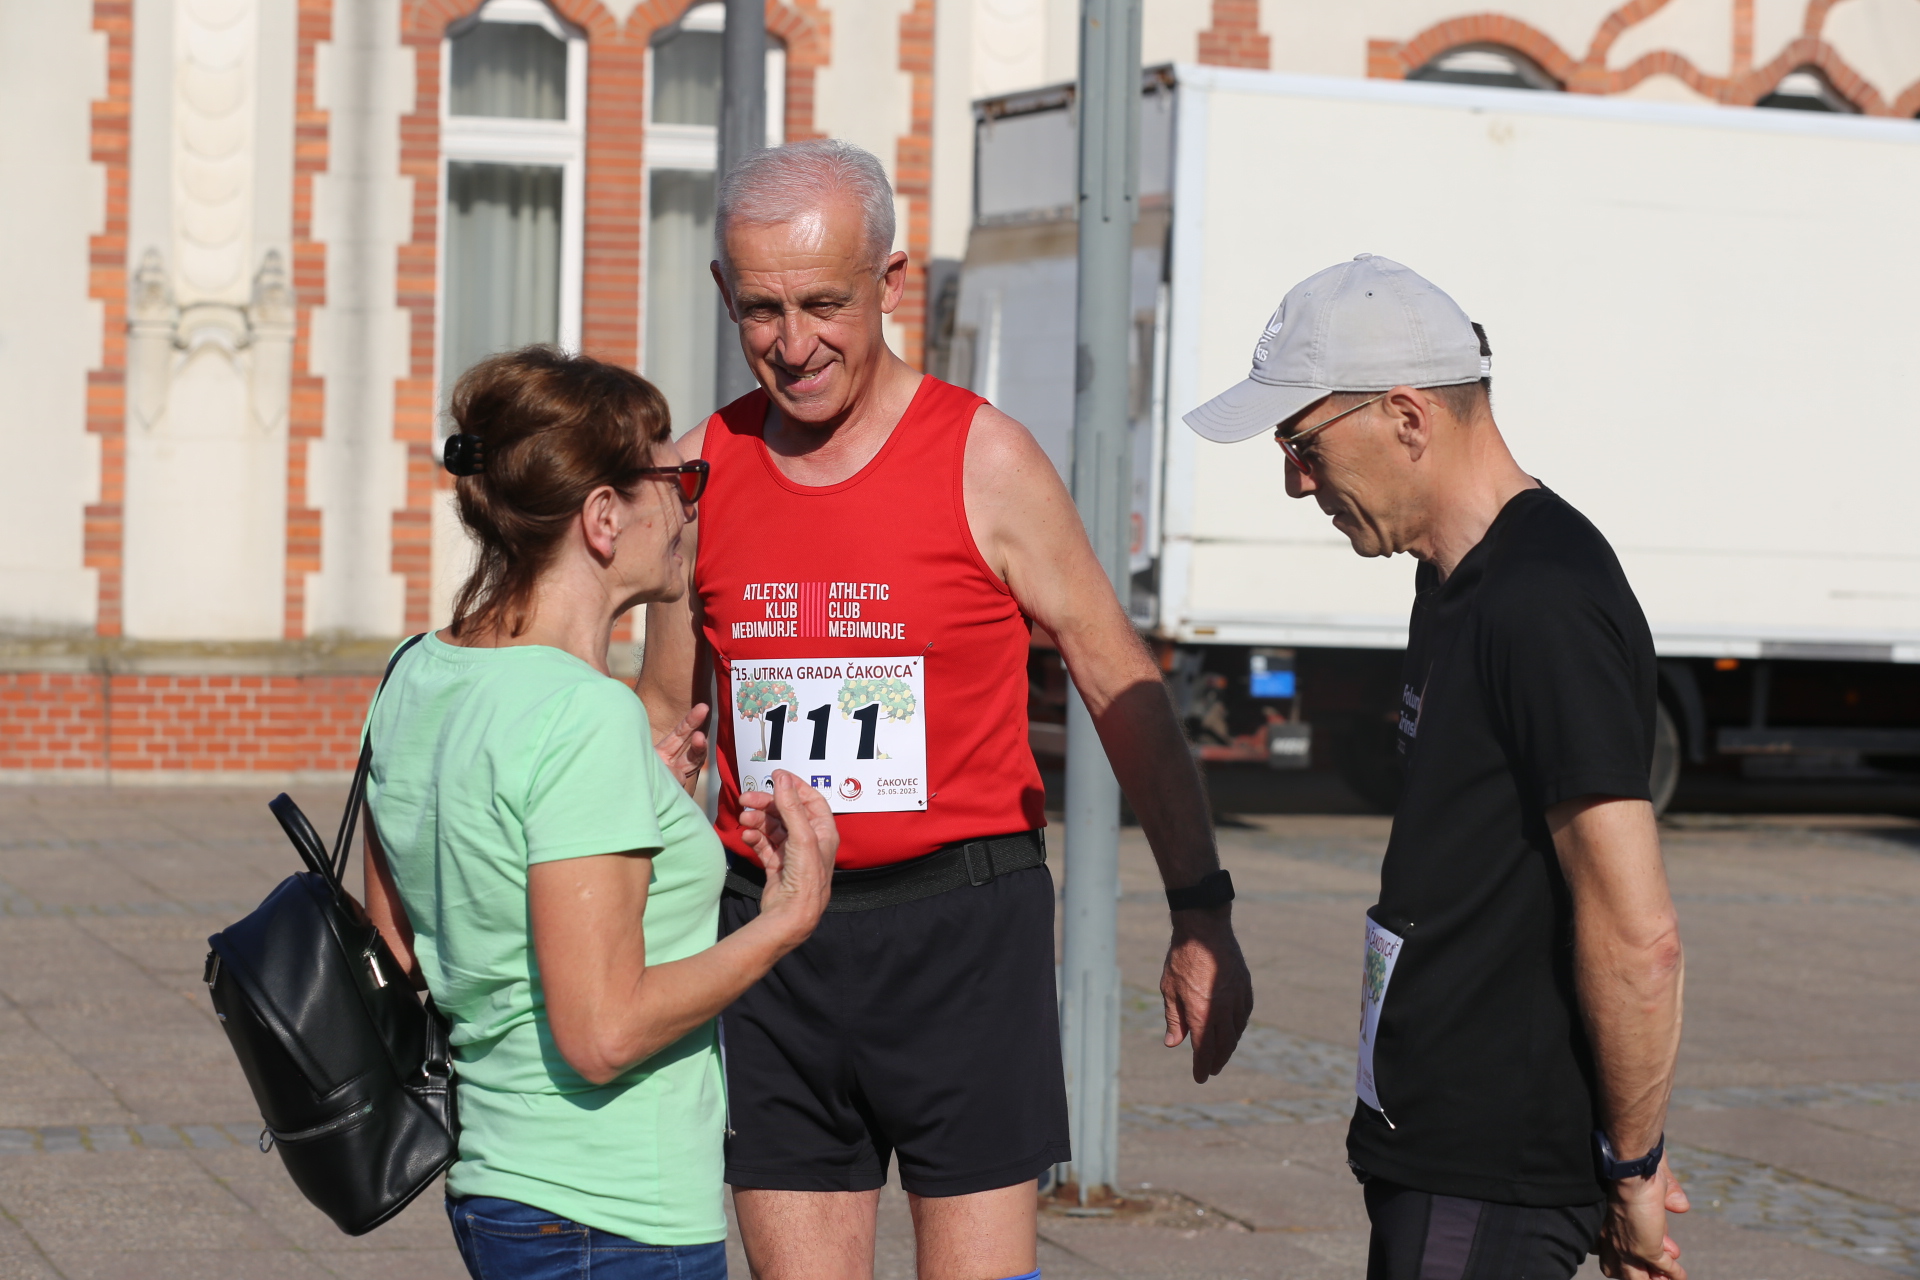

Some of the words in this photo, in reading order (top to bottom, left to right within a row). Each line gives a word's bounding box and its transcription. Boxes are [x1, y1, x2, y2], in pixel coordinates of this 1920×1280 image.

[743, 583, 798, 600] ATLETSKI
[828, 582, 890, 601] ATHLETIC
[765, 602, 798, 619] KLUB
[828, 602, 861, 619] CLUB
[731, 621, 798, 639] MEĐIMURJE
[828, 621, 906, 640] MEĐIMURJE
[735, 667, 751, 681] 15.
[753, 667, 793, 680] UTRKA
[796, 666, 842, 680] GRADA
[846, 662, 913, 679] ČAKOVCA
[764, 703, 880, 761] 111
[877, 777, 918, 787] ČAKOVEC
